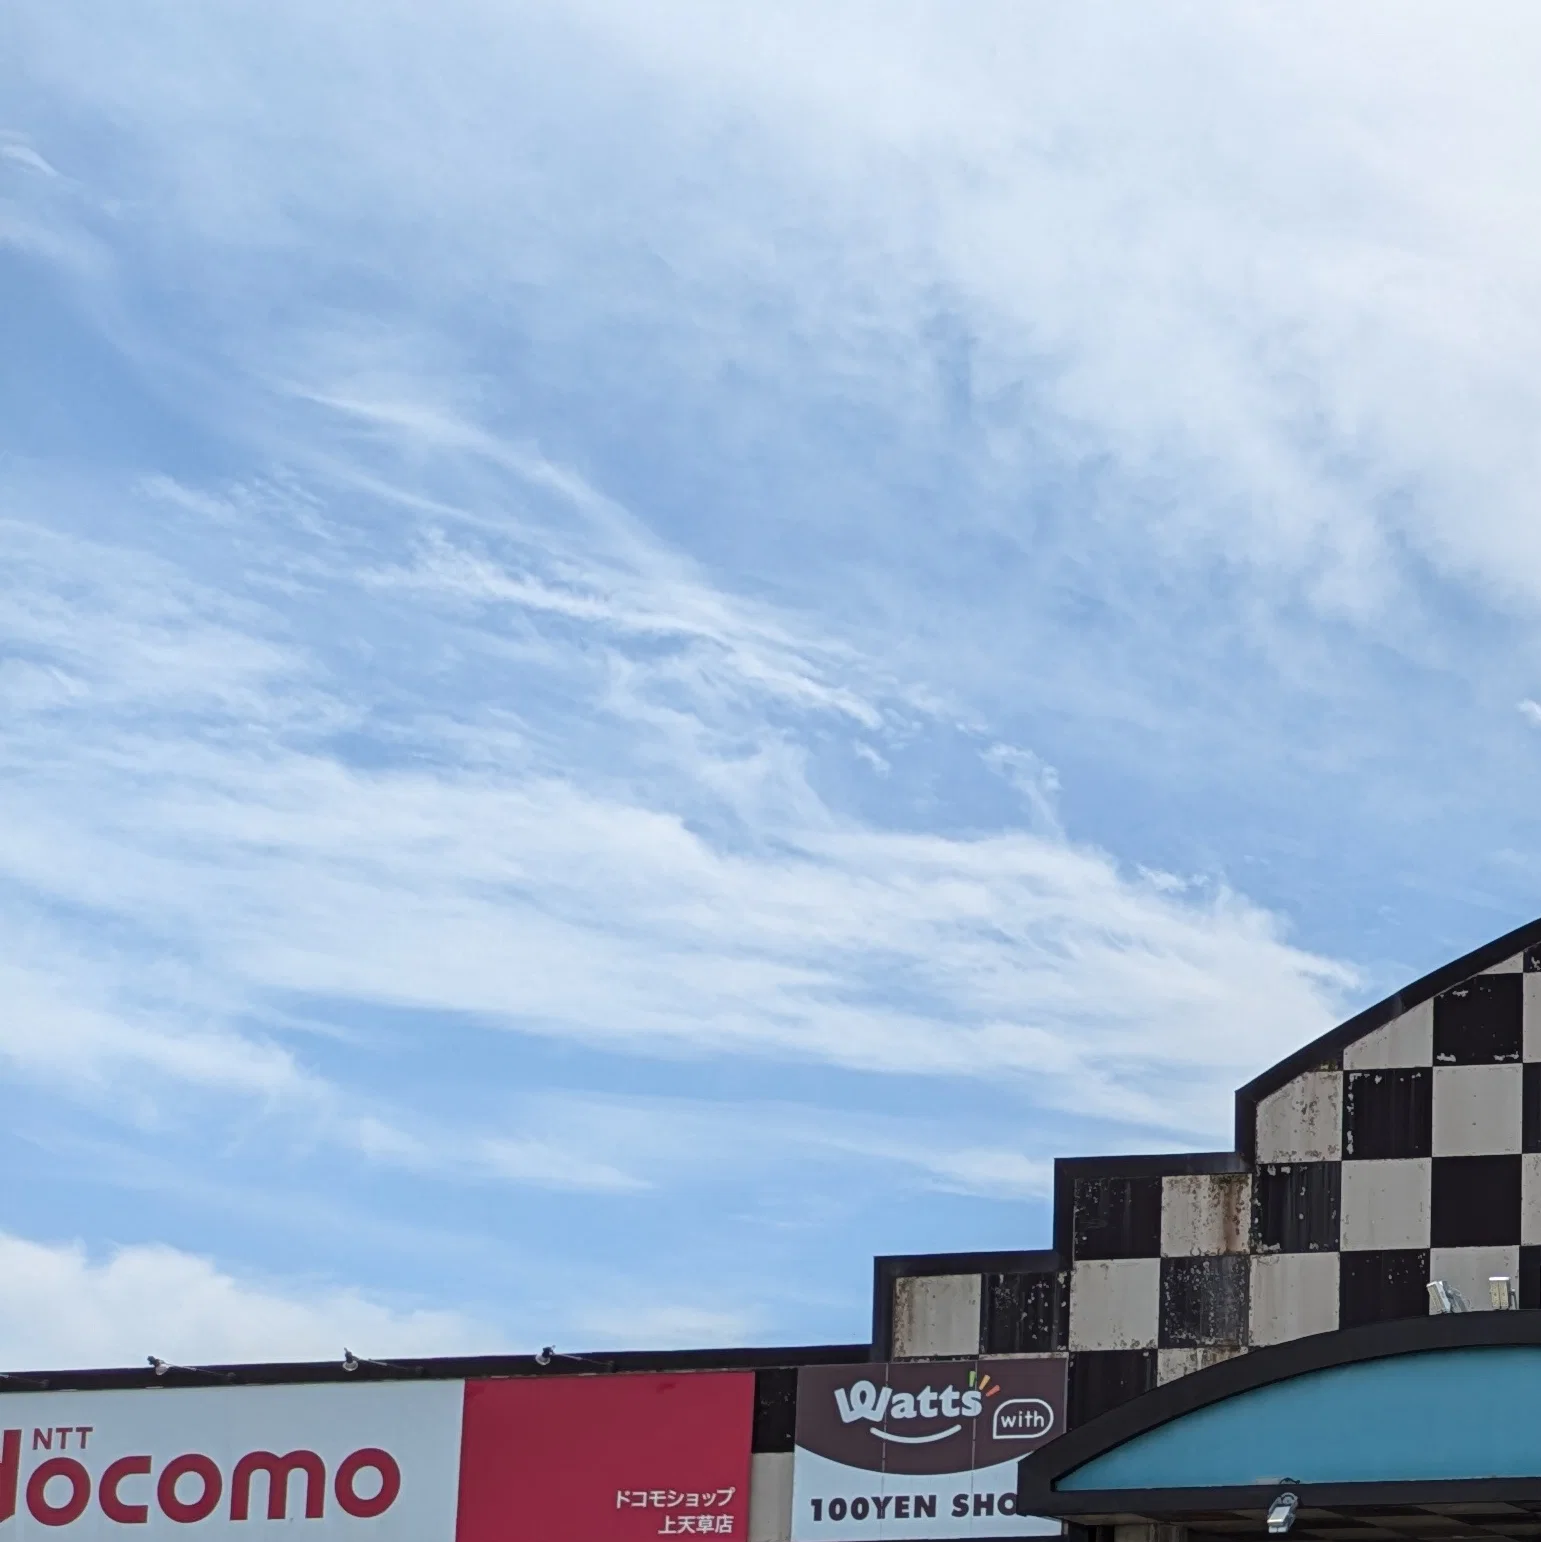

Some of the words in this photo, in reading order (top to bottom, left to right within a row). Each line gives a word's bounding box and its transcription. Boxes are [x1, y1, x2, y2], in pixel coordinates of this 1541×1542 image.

[834, 1380, 982, 1423] Watts
[1000, 1411, 1045, 1428] with
[32, 1427, 93, 1450] NTT
[616, 1486, 736, 1509] ドコモショップ
[811, 1494, 937, 1522] 100YEN
[951, 1492, 1018, 1518] SHO
[657, 1514, 735, 1534] 上天草店
